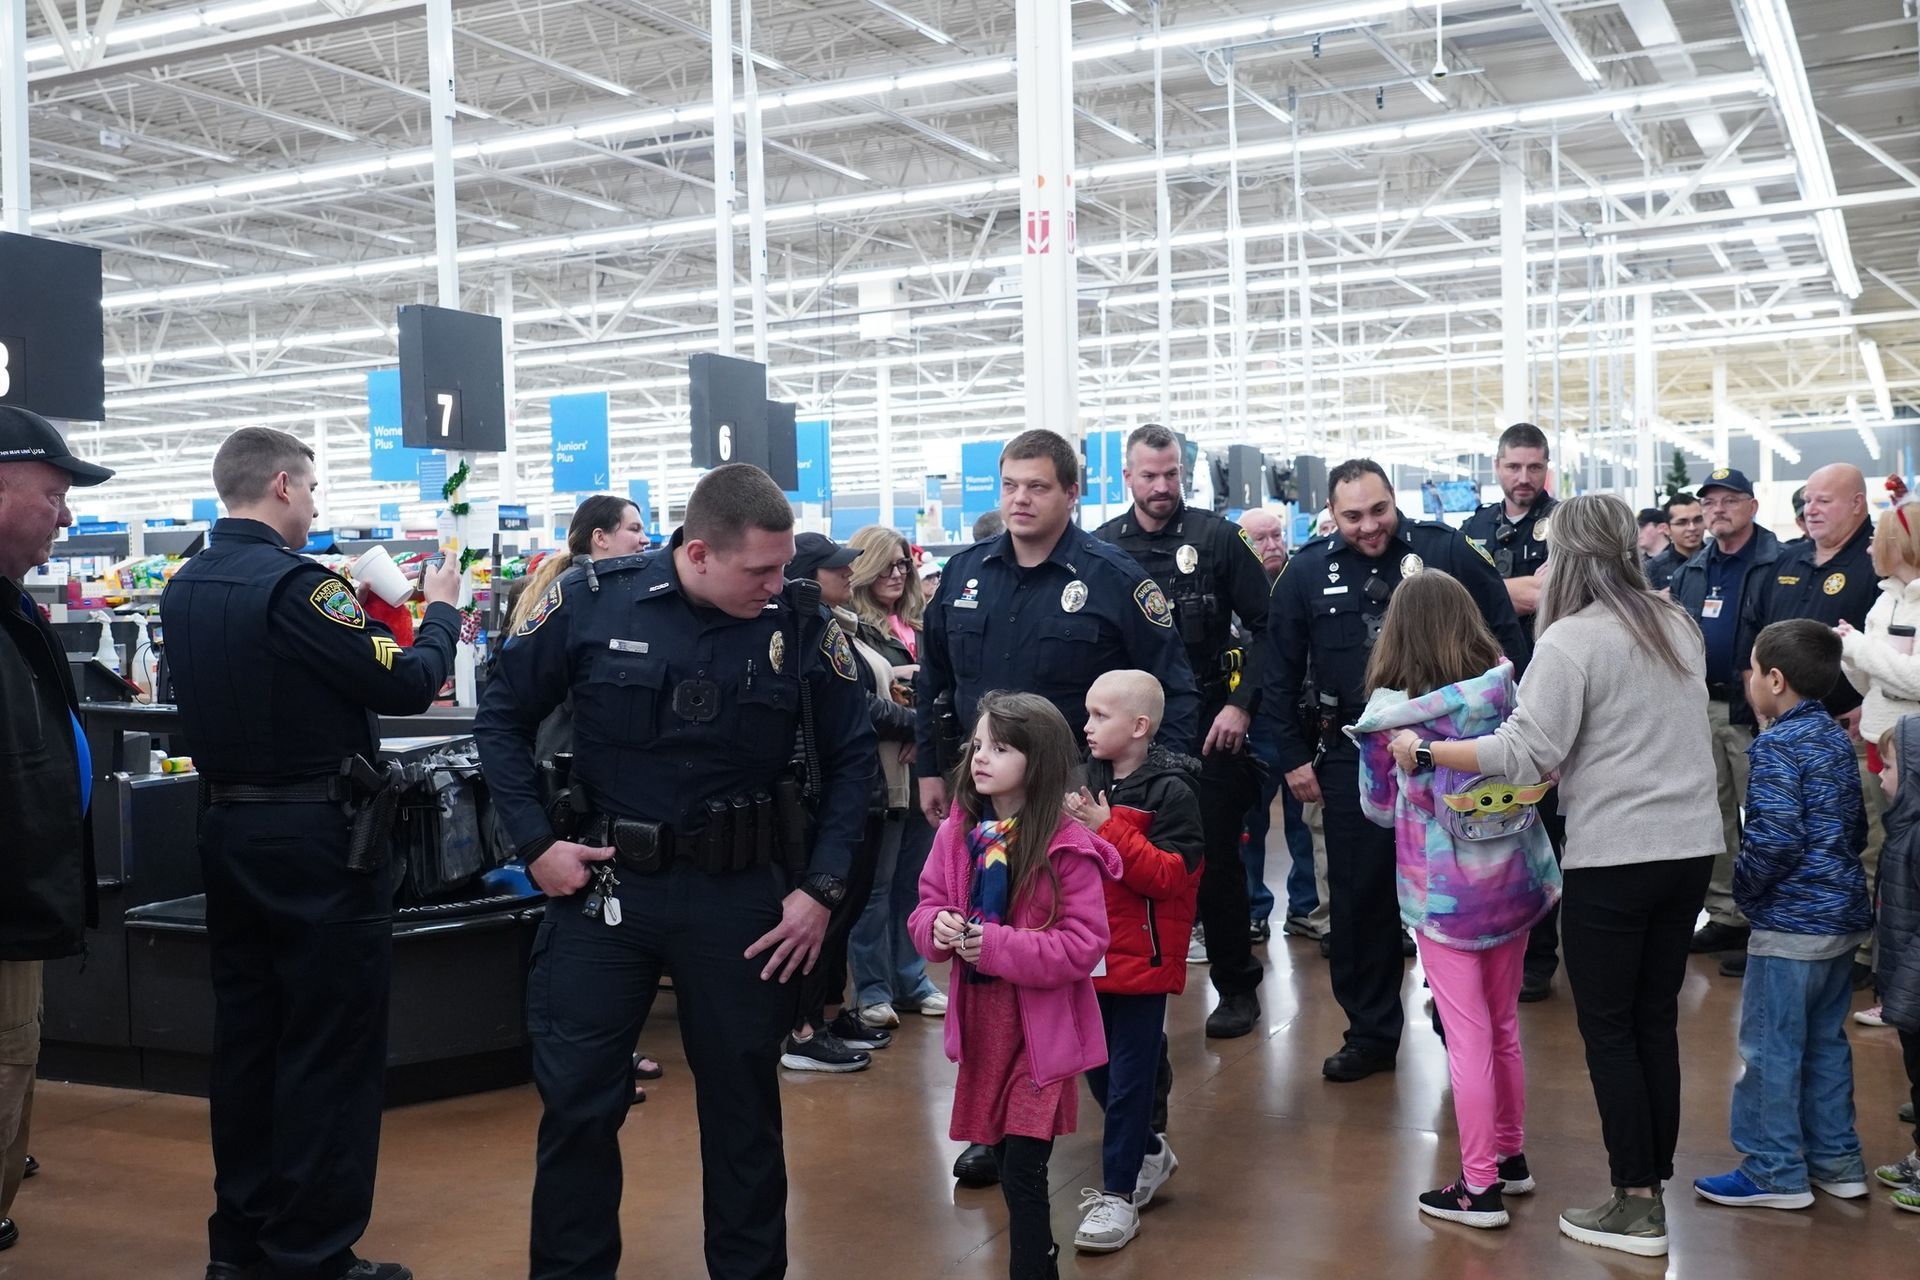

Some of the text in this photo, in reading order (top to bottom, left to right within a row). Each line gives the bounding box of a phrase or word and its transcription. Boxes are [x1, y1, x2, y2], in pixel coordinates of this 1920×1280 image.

[437, 393, 453, 437] 7
[375, 438, 394, 449] Plus
[719, 424, 731, 461] 6
[556, 452, 575, 463] Plus
[399, 902, 470, 912] MORE
